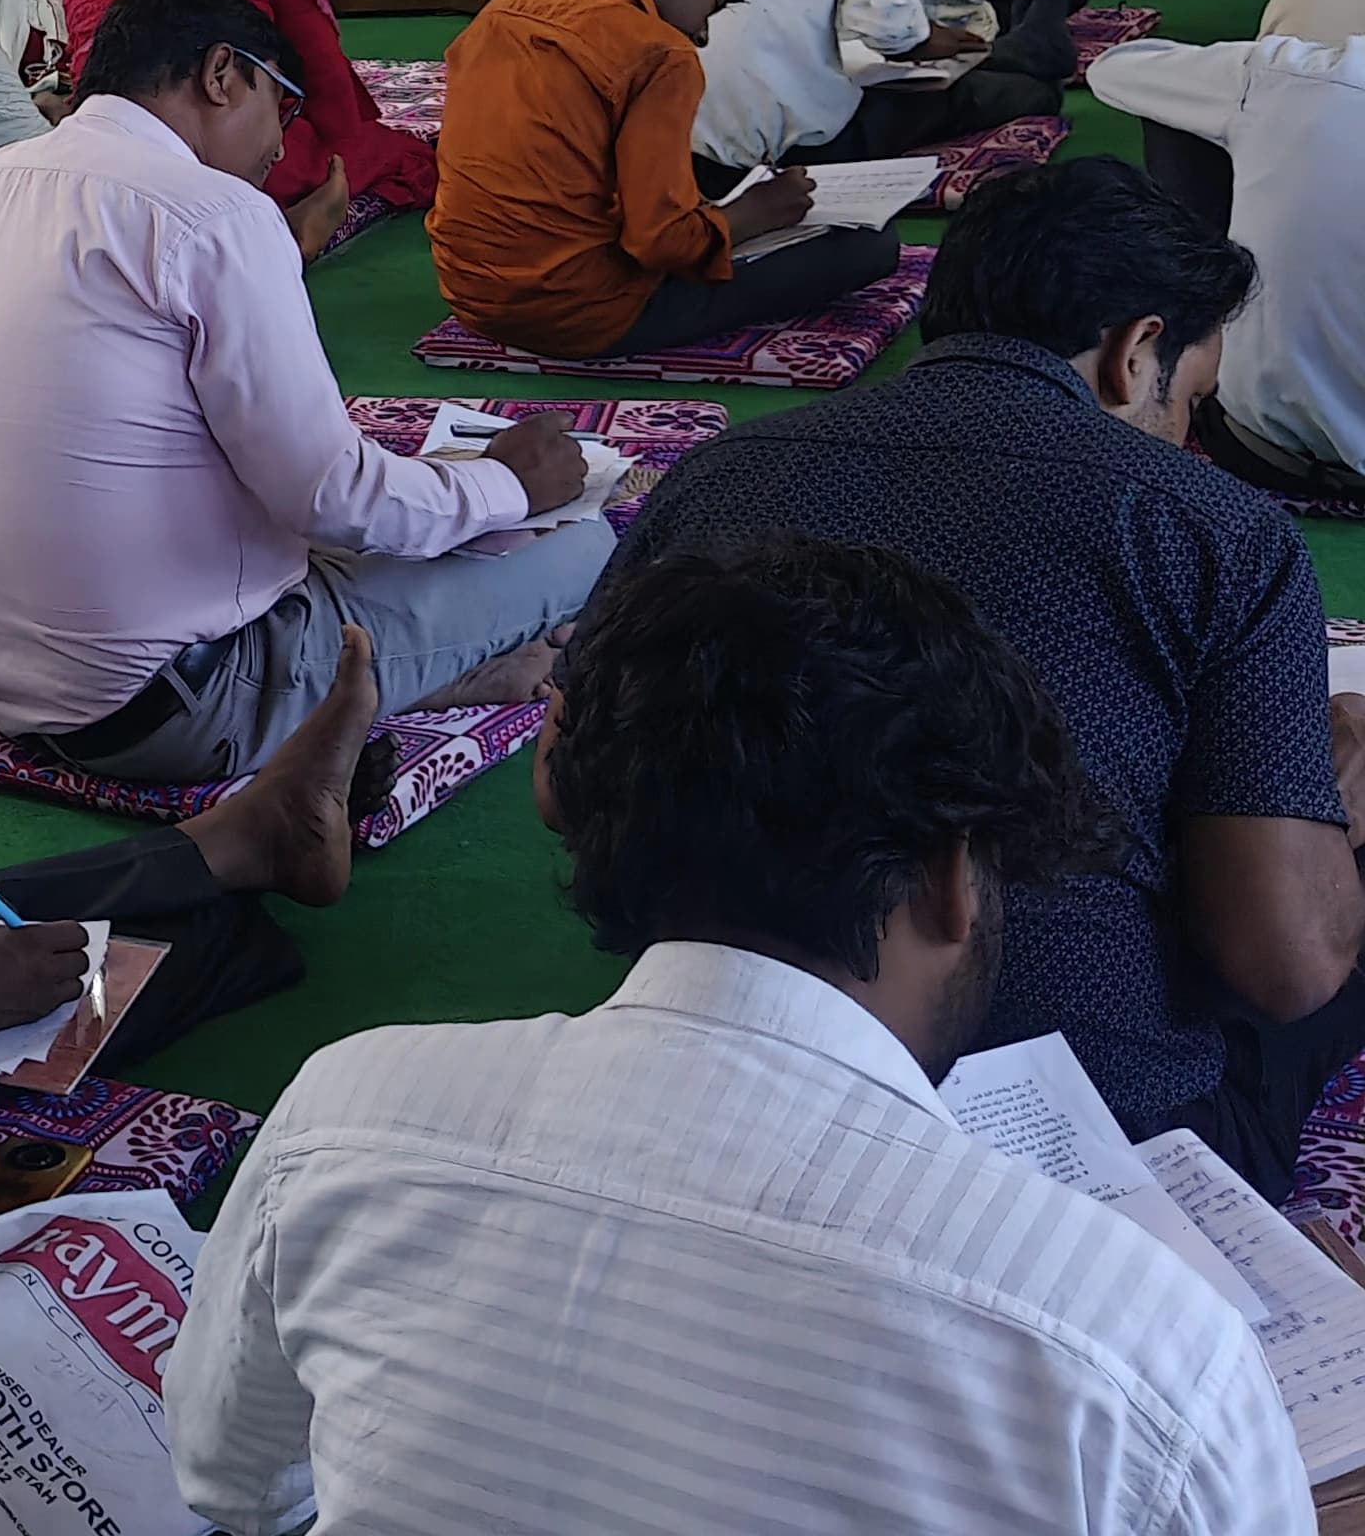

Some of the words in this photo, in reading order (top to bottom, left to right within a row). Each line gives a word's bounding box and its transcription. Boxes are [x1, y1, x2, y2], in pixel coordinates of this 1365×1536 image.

[28, 1410, 87, 1477] DEALER
[13, 1465, 57, 1505] ETAH
[30, 1453, 121, 1536] STORE
